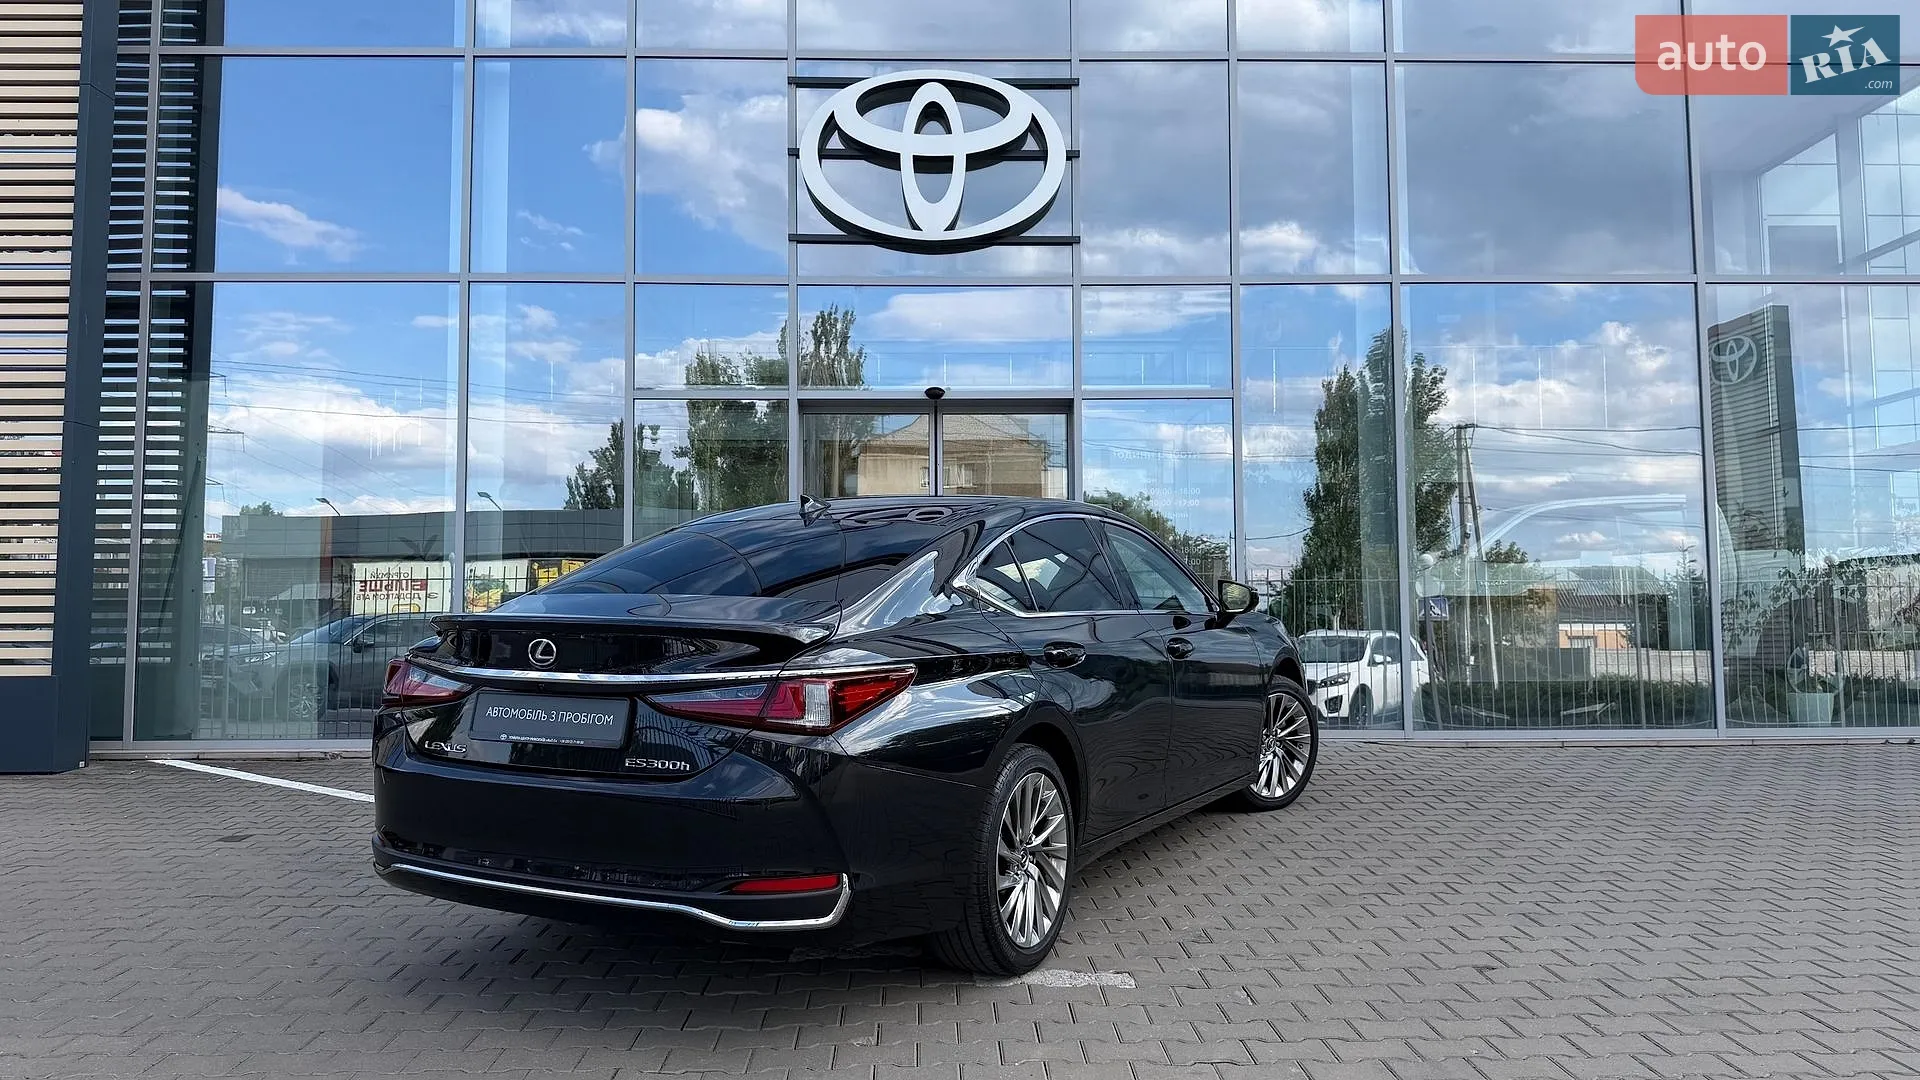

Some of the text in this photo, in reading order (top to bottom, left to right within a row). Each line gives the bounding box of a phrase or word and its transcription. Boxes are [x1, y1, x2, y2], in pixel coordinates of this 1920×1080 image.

[486, 706, 614, 726] АВТОМОБІЛЬ З ПРОБІГОМ
[424, 740, 467, 753] LEXUS
[624, 757, 690, 771] ES300h
